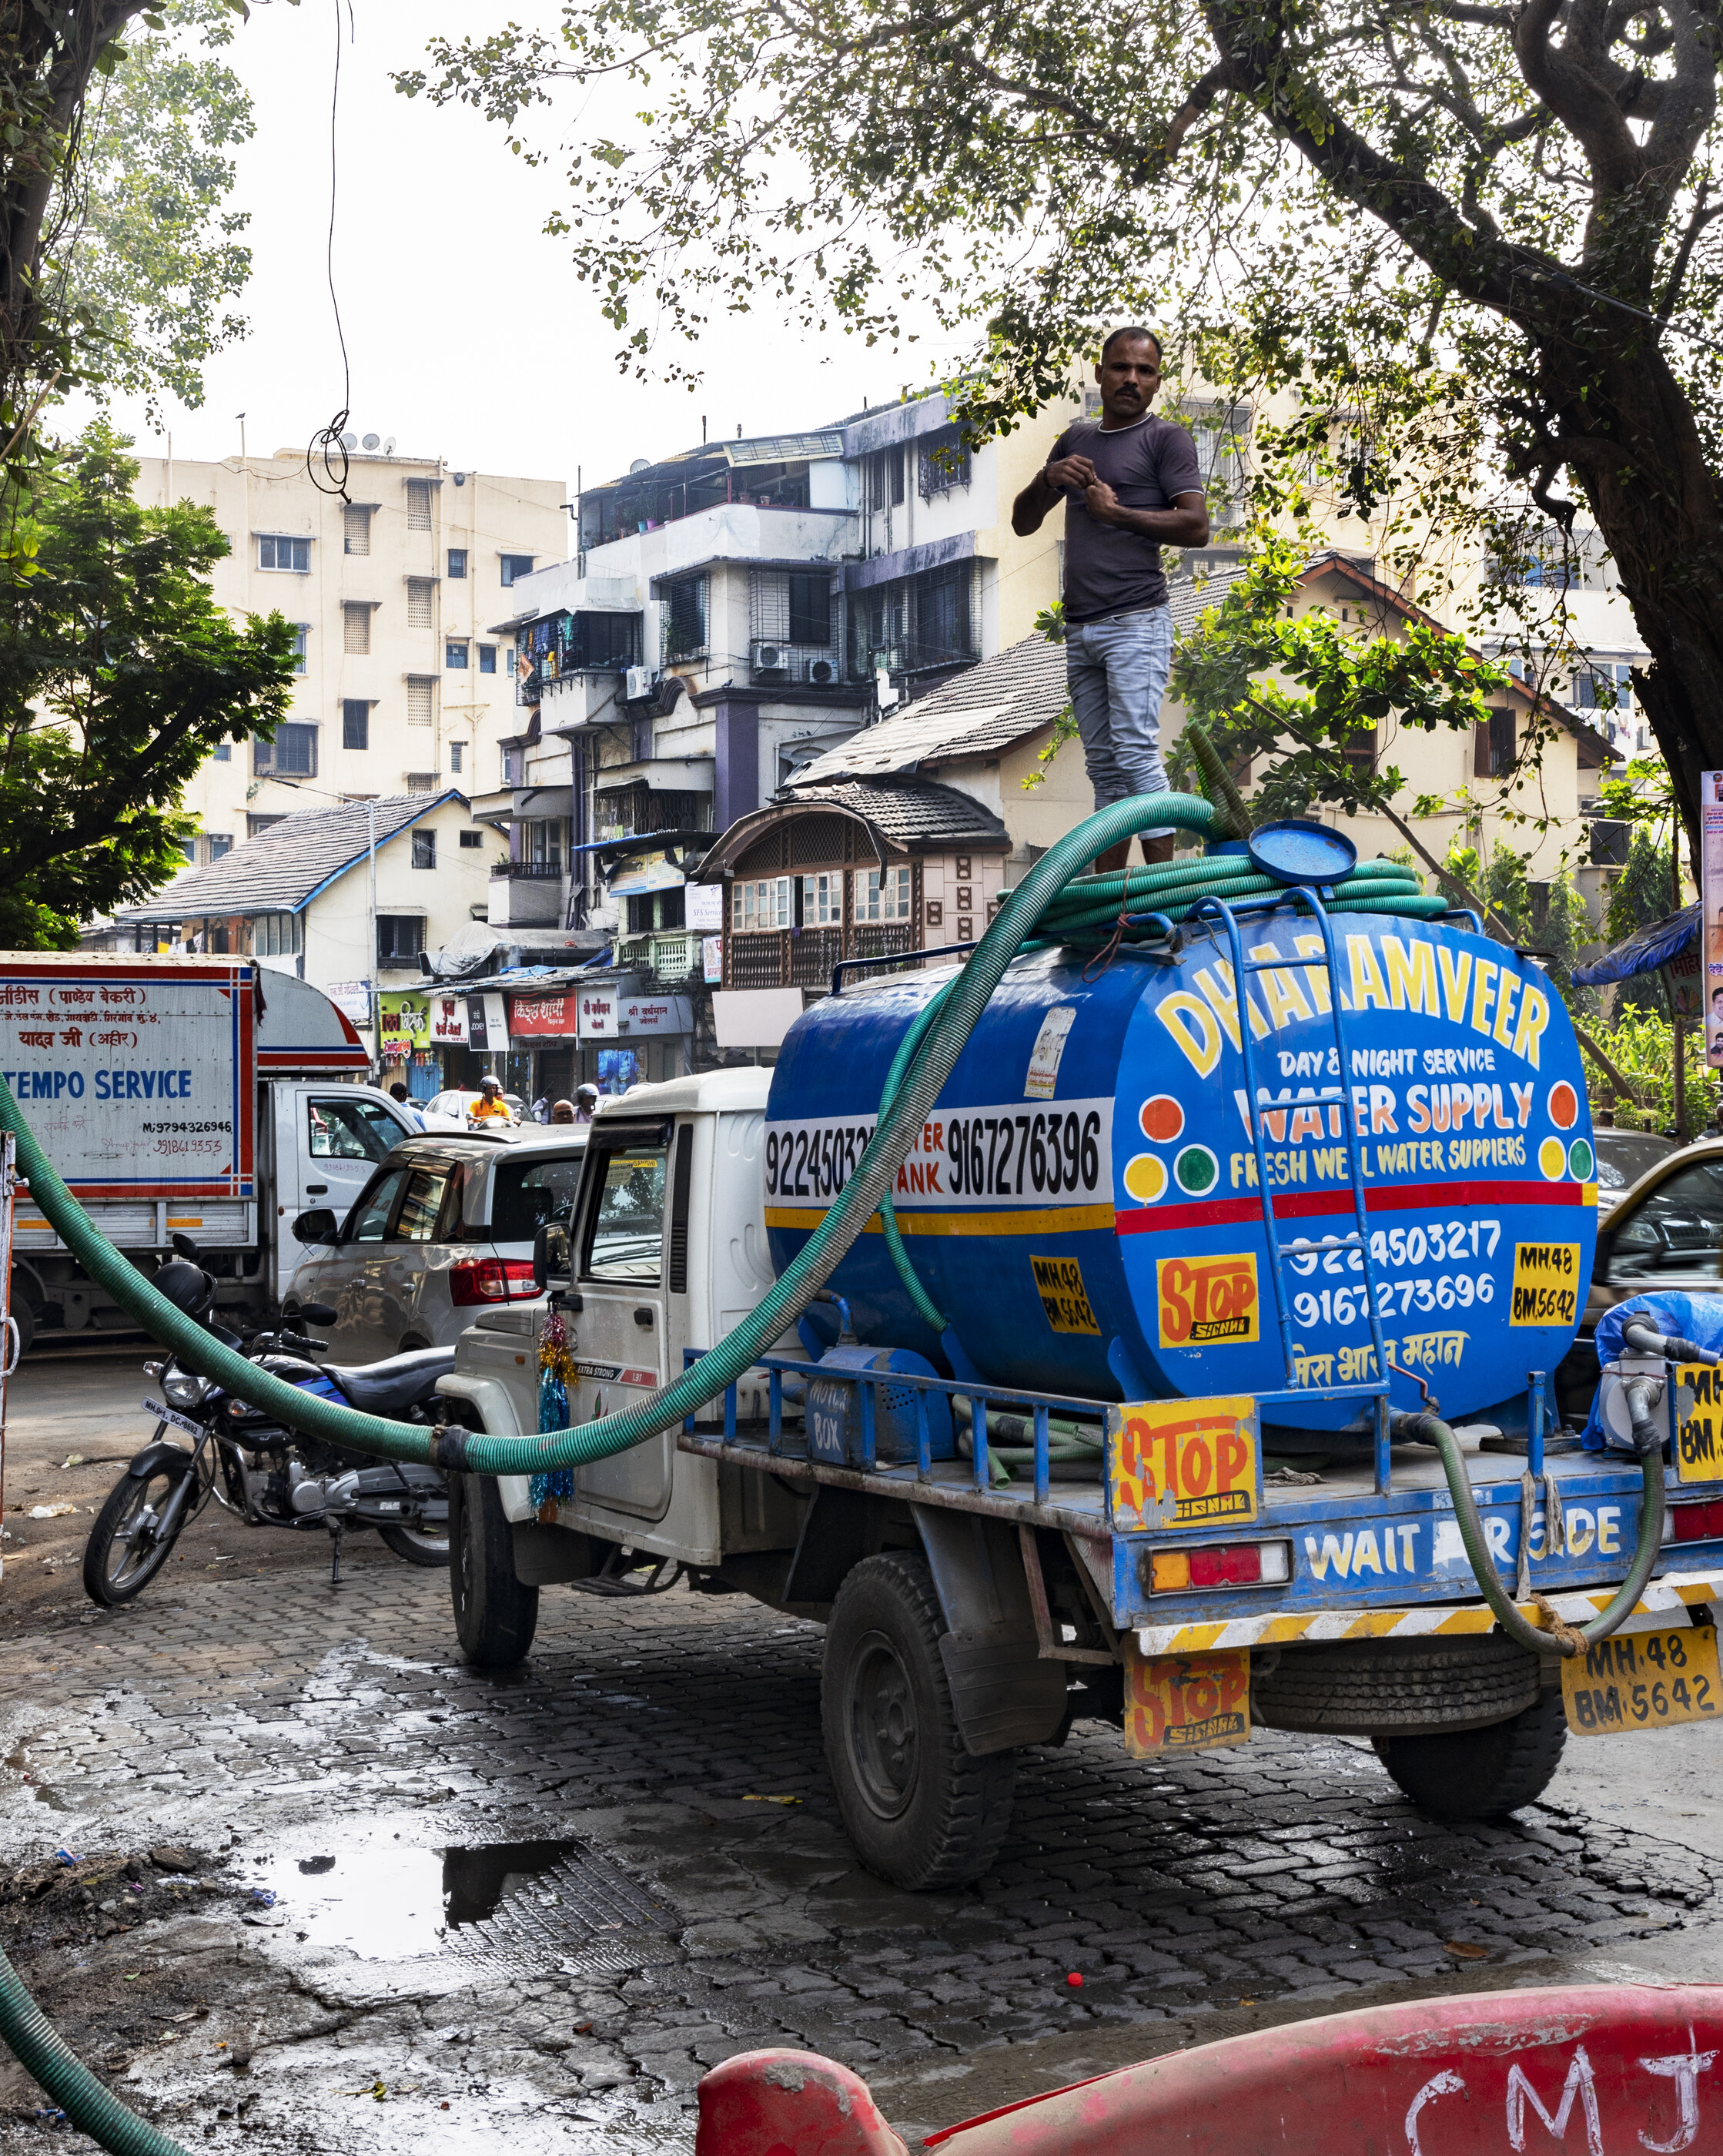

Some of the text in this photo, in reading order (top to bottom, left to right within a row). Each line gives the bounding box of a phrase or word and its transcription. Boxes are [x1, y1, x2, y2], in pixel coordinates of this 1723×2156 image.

[470, 1023, 485, 1031] JOCKEY
[628, 1004, 667, 1016] श्री वर्धमान
[1156, 933, 1550, 1080] DHARAMVEER
[18, 1031, 55, 1050] यादव
[59, 1026, 82, 1048] जी
[1276, 1050, 1324, 1078] DAY
[1351, 1047, 1417, 1078] NIGHT
[1422, 1046, 1496, 1077] SERVICE
[95, 1070, 192, 1100] SERVICE
[1233, 1081, 1535, 1145] WATER SUPPLY
[153, 1140, 222, 1155] 9918619353
[948, 1111, 1100, 1195] 9167276396
[1230, 1150, 1307, 1189] FRESH
[1312, 1147, 1375, 1180] WEL
[1377, 1140, 1447, 1176] WATER
[890, 1161, 945, 1197] ANK
[1289, 1220, 1501, 1277] 9224503217
[1161, 1259, 1258, 1342] STOP
[1293, 1273, 1495, 1327] 9167273696
[1191, 1317, 1250, 1341] SIGNAL
[577, 1365, 614, 1378] EXTRA STRONG
[1402, 1331, 1471, 1376] महान
[813, 1411, 841, 1452] BOX
[1120, 1415, 1249, 1525] STOP
[1304, 1523, 1420, 1582] WAIT
[1528, 1506, 1622, 1561] SDE
[1132, 1653, 1247, 1750] STOP
